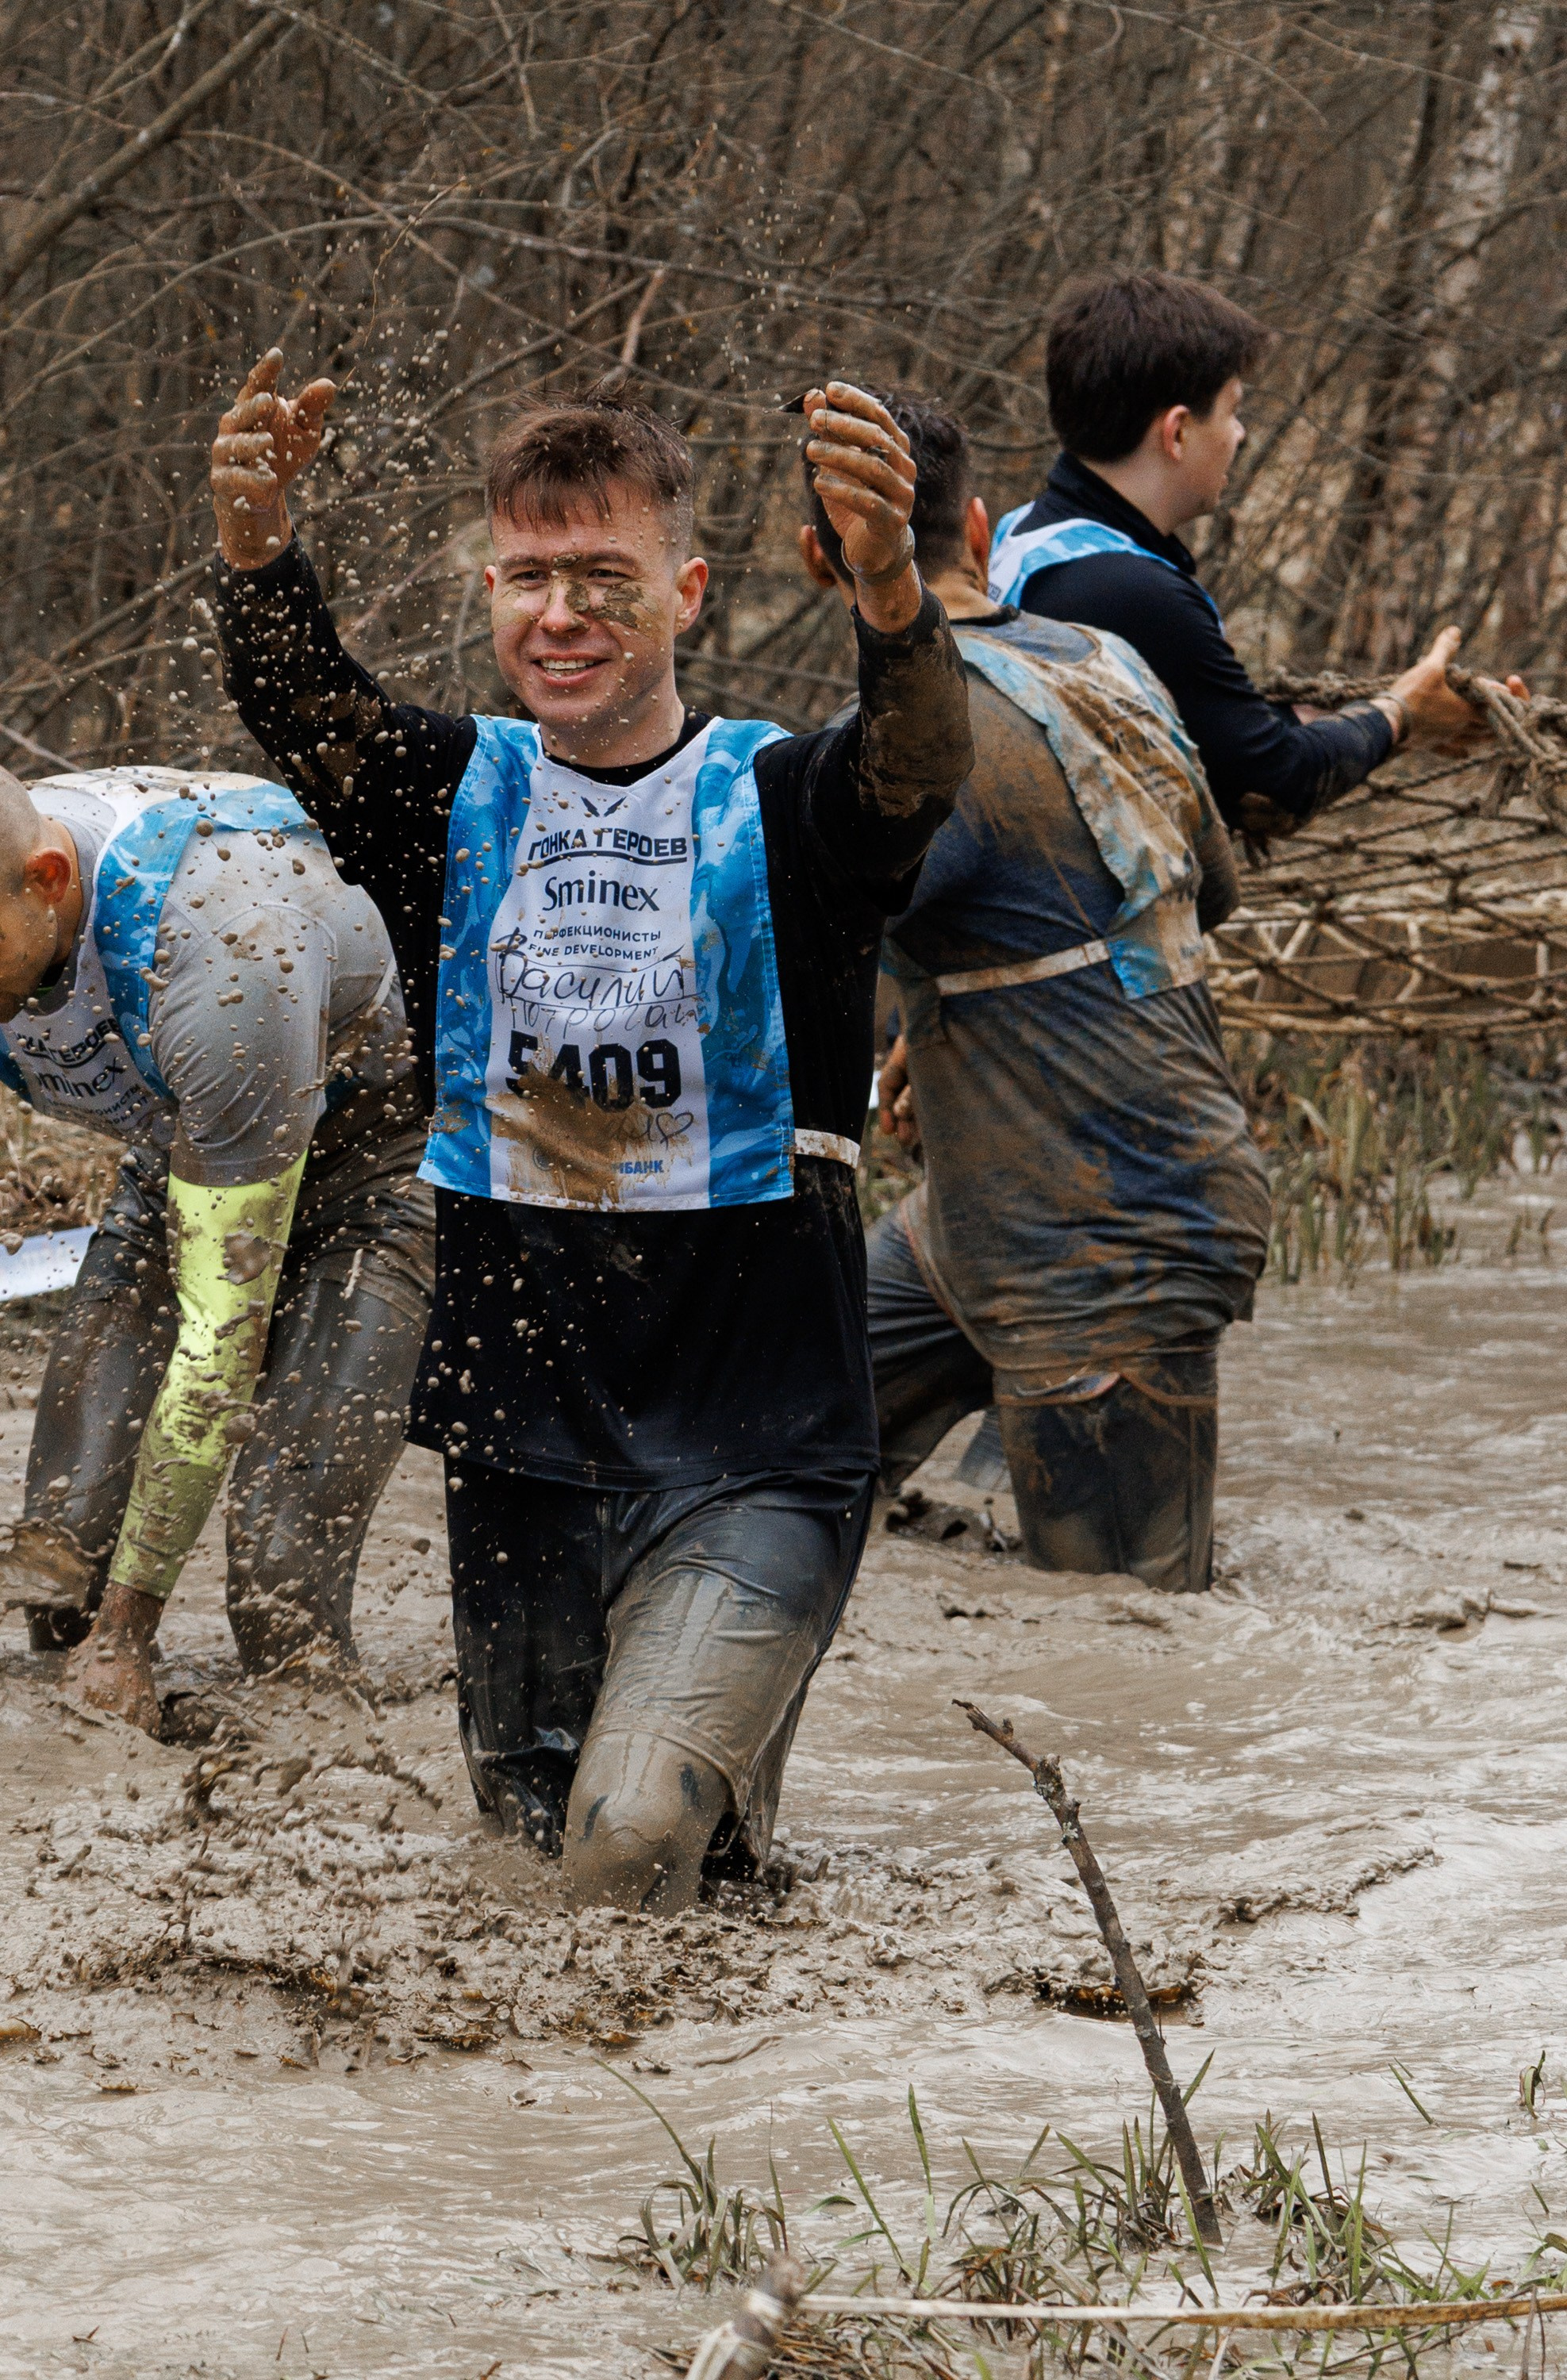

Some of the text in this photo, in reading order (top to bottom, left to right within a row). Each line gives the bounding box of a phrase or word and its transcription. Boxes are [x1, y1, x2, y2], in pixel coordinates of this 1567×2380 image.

[527, 827, 688, 861] ГОНКА ГЕРОЕВ
[542, 869, 660, 912] Sminex
[563, 943, 658, 961] DEVELOPMENT
[35, 1057, 127, 1098] minex
[505, 1030, 682, 1113] 5409
